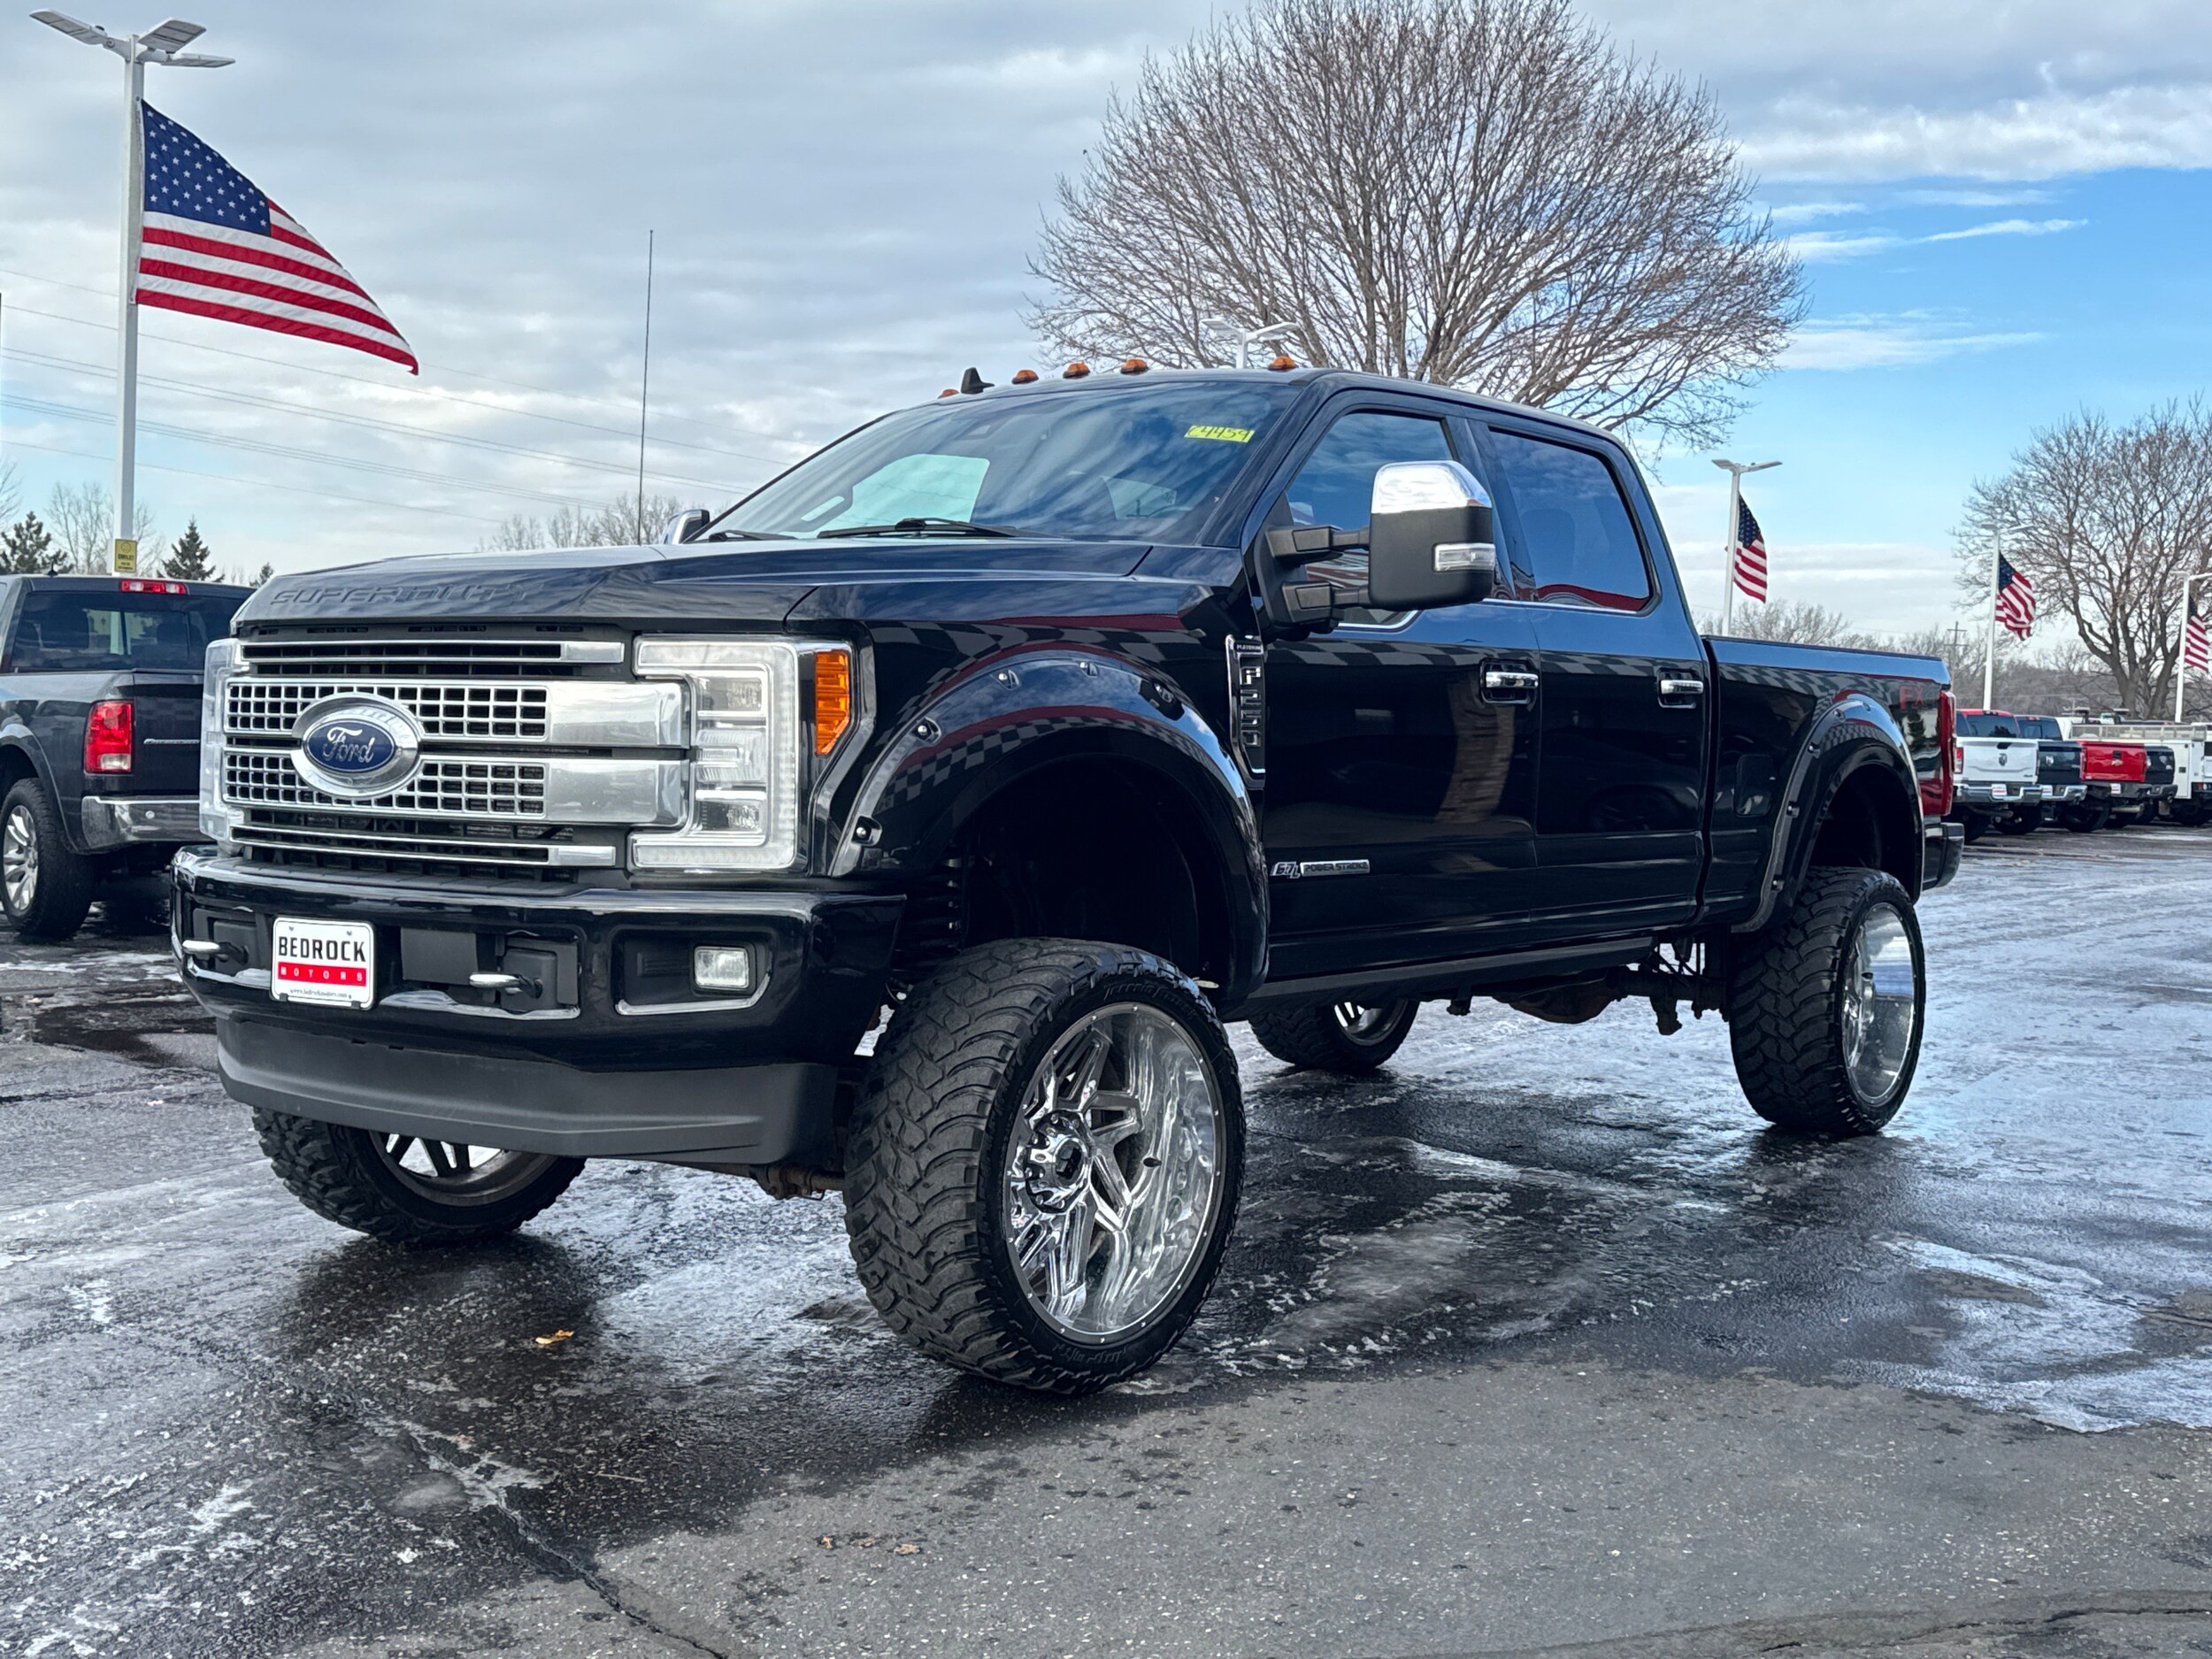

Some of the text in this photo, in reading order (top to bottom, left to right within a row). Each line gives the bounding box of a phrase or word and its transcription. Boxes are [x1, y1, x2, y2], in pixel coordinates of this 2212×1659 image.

[270, 583, 543, 606] SUPER DUTY
[322, 726, 376, 764] Ford
[1303, 864, 1333, 873] POWER
[1335, 861, 1369, 872] STROKE
[278, 936, 366, 963] BEDROCK
[280, 965, 363, 982] MOTORS
